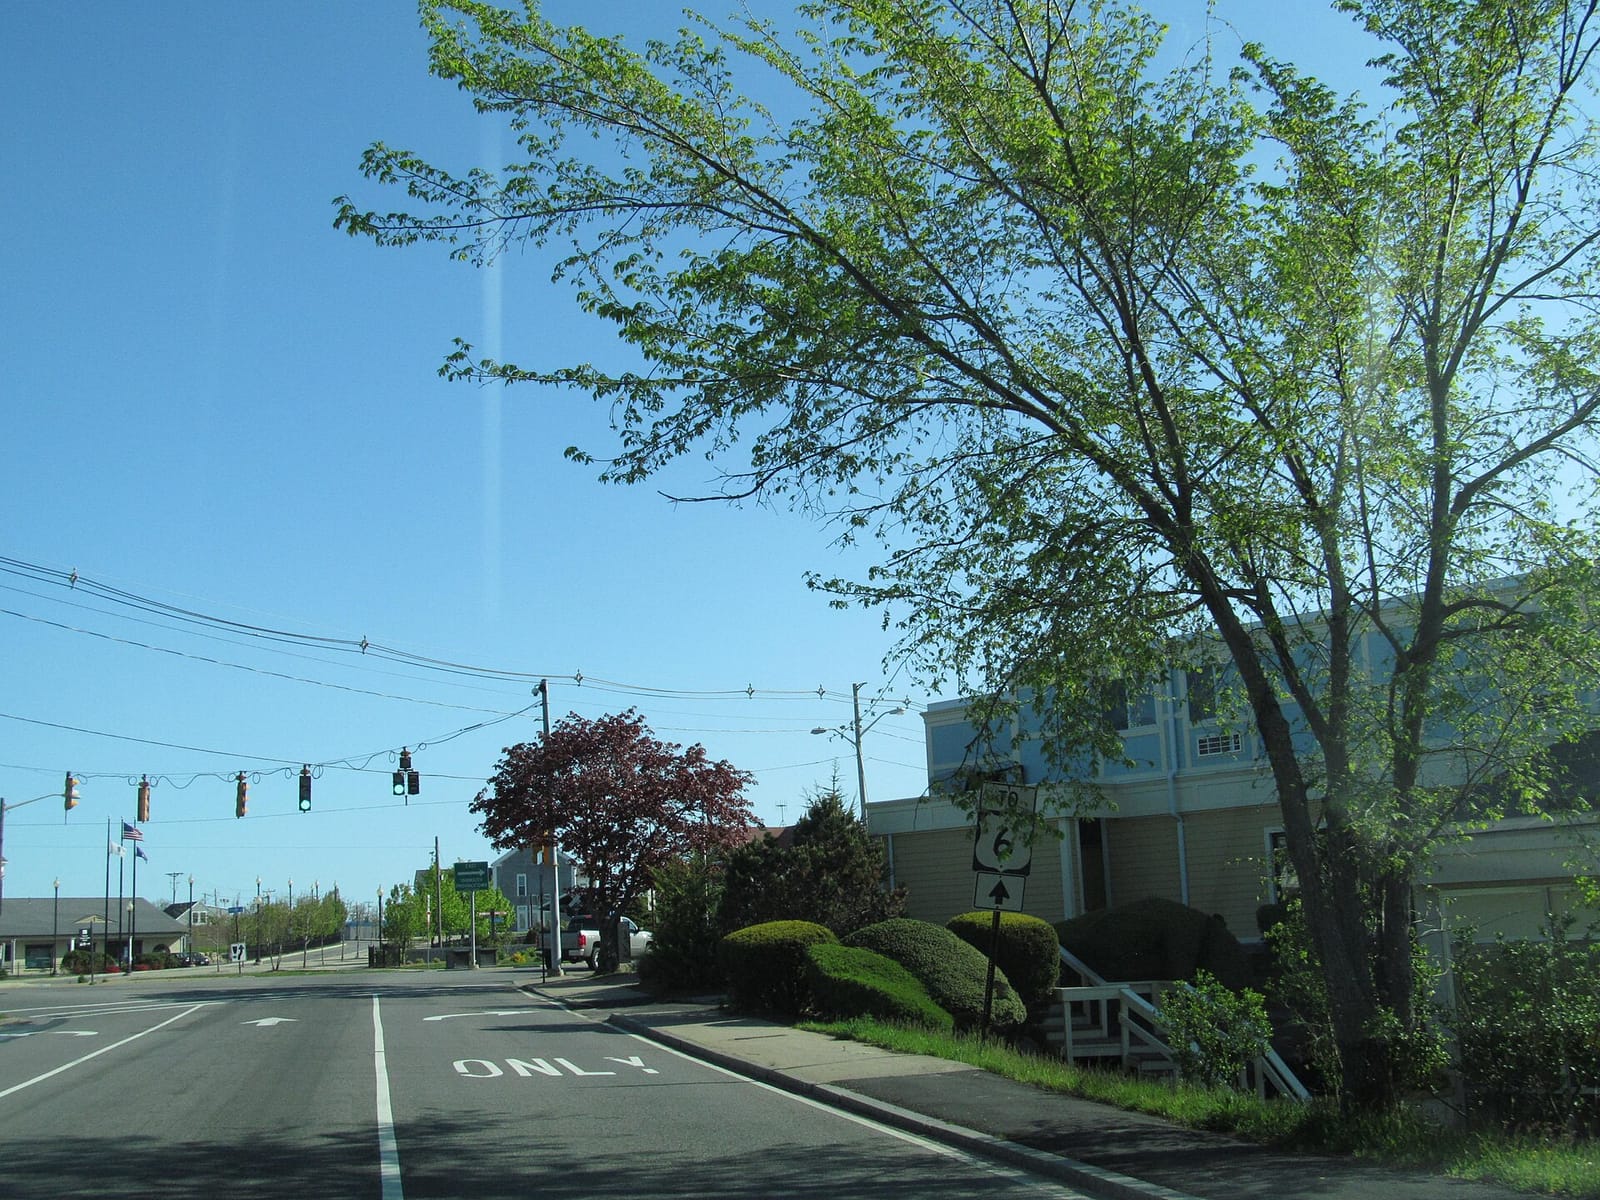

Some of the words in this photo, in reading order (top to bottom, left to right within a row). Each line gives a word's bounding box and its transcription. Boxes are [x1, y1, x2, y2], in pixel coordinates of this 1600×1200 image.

[998, 790, 1018, 807] TO
[993, 826, 1014, 859] 6
[452, 1056, 660, 1078] ONLY
